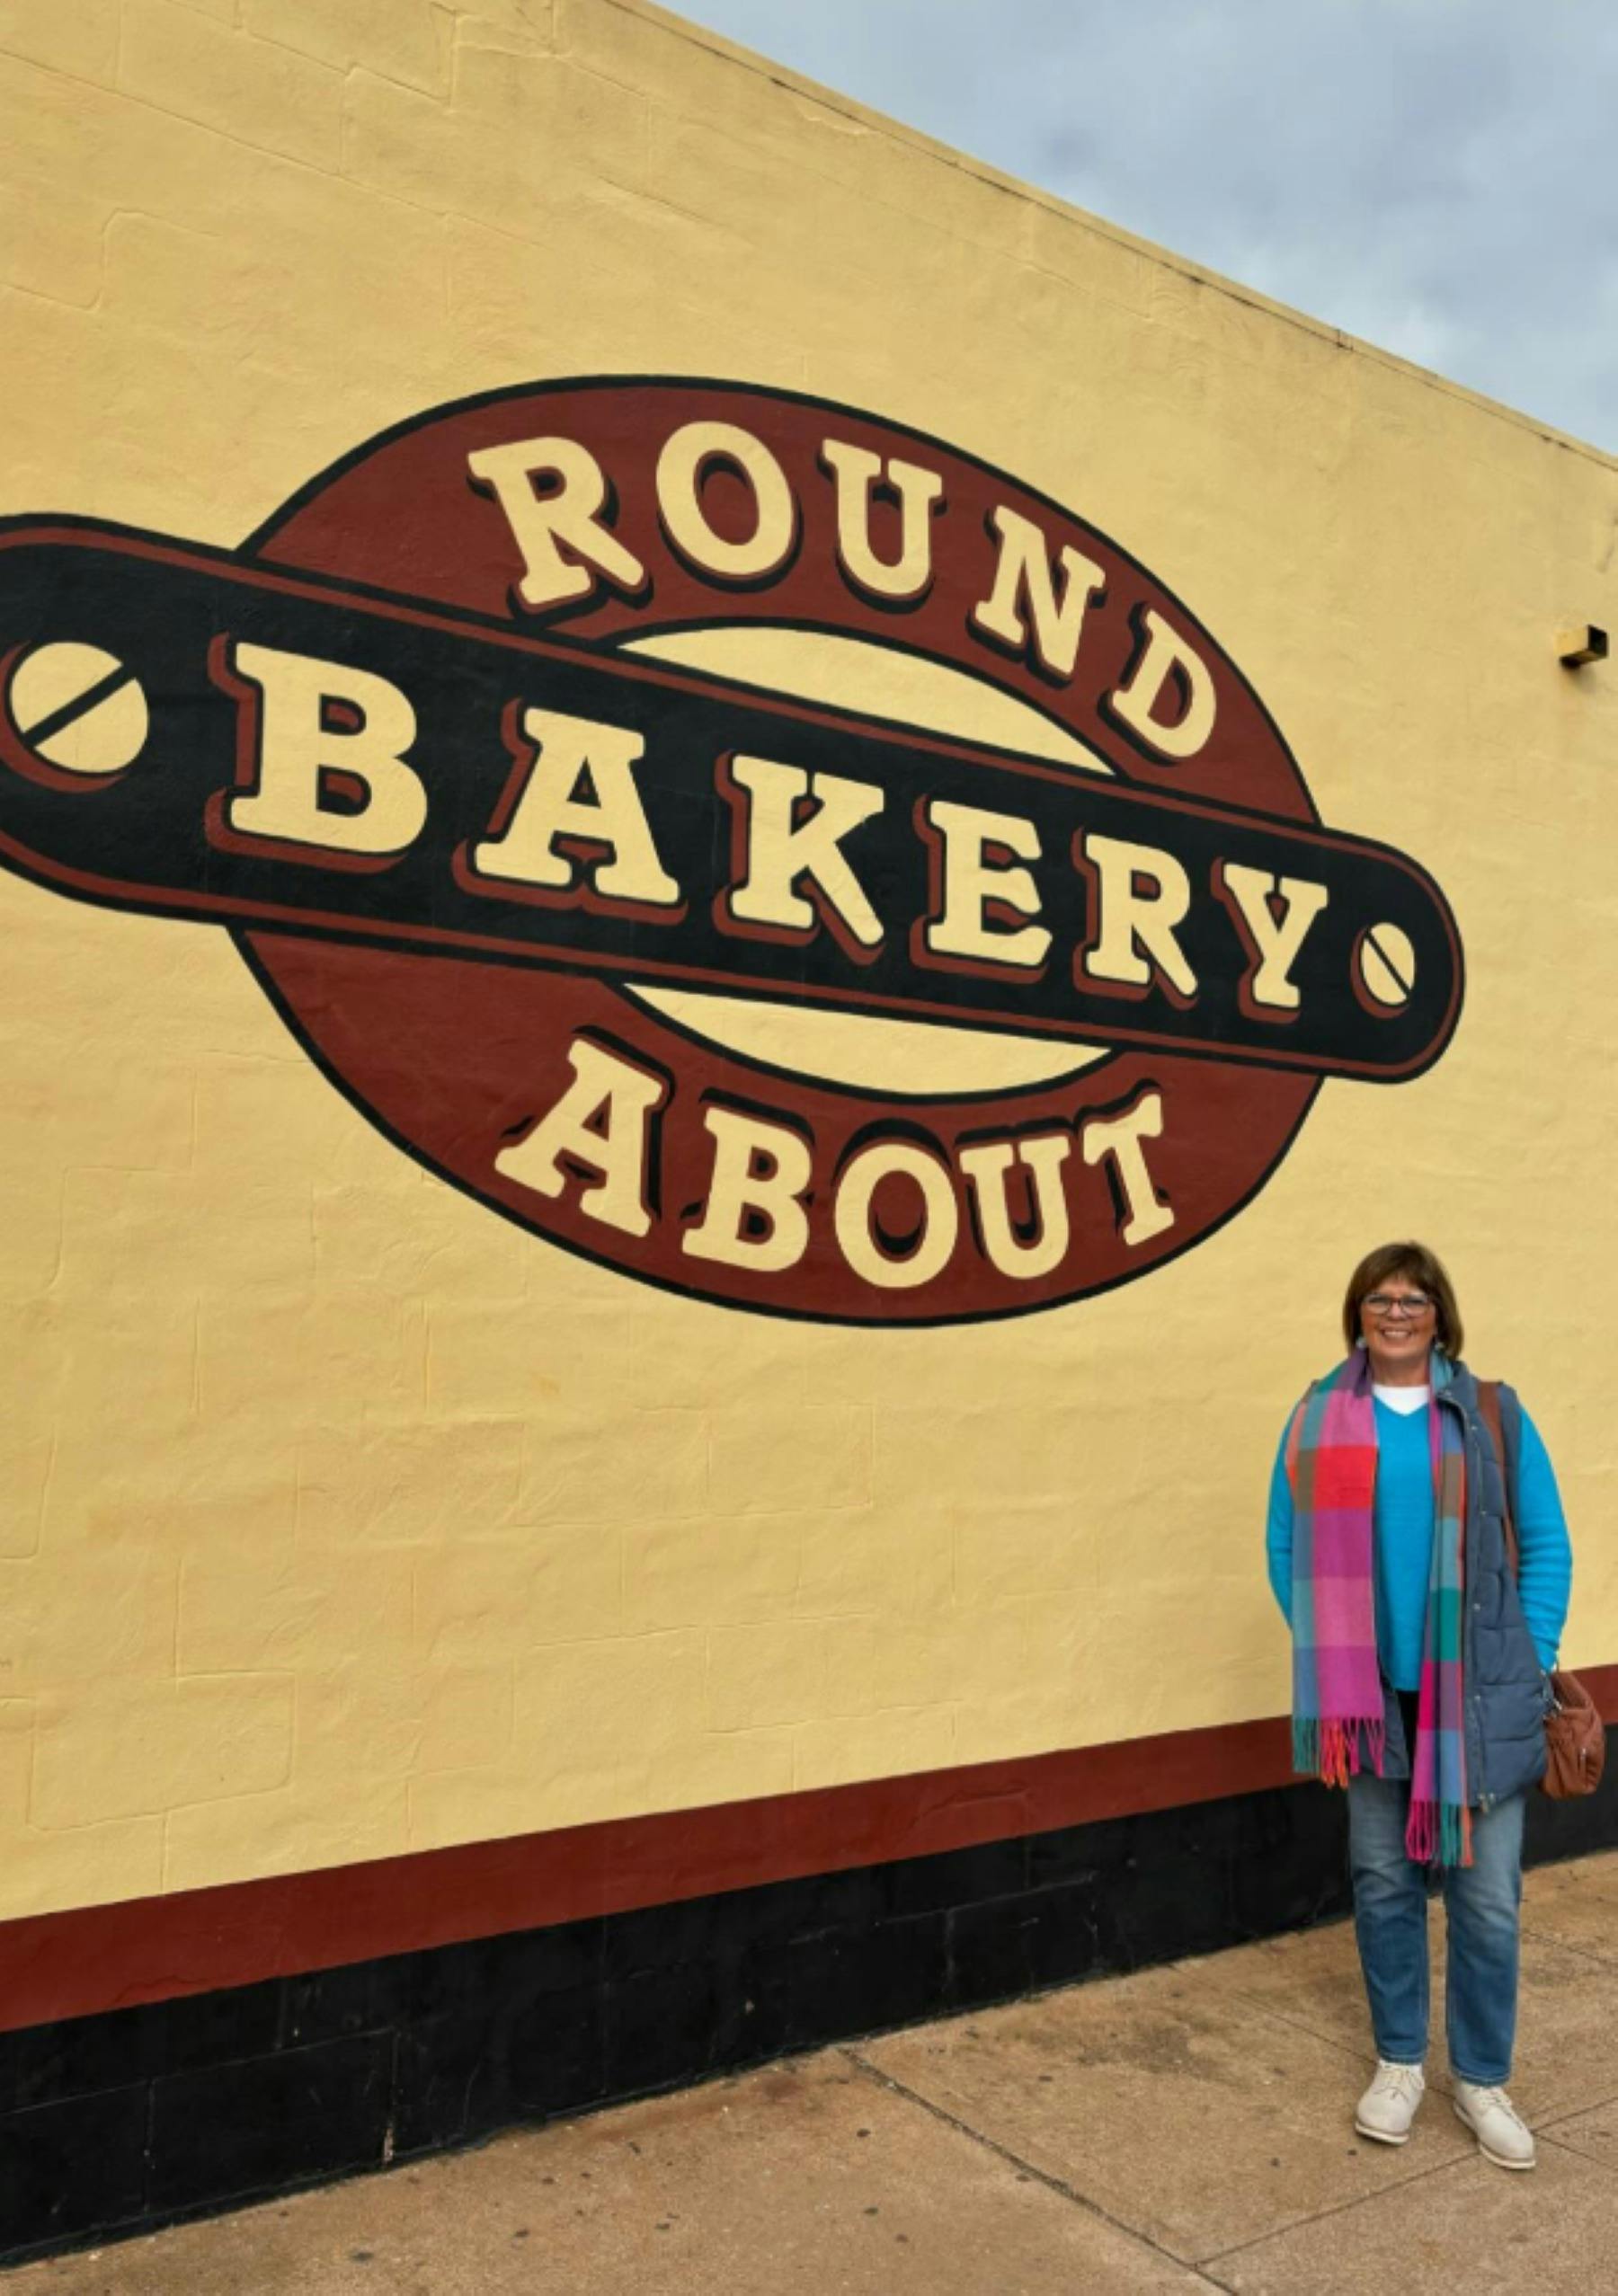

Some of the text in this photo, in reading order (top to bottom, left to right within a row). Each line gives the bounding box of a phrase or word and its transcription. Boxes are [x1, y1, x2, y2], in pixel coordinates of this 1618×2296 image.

[467, 421, 1217, 758] ROUND
[230, 642, 1329, 1008] BAKERY
[493, 1039, 1176, 1289] ABOUT
